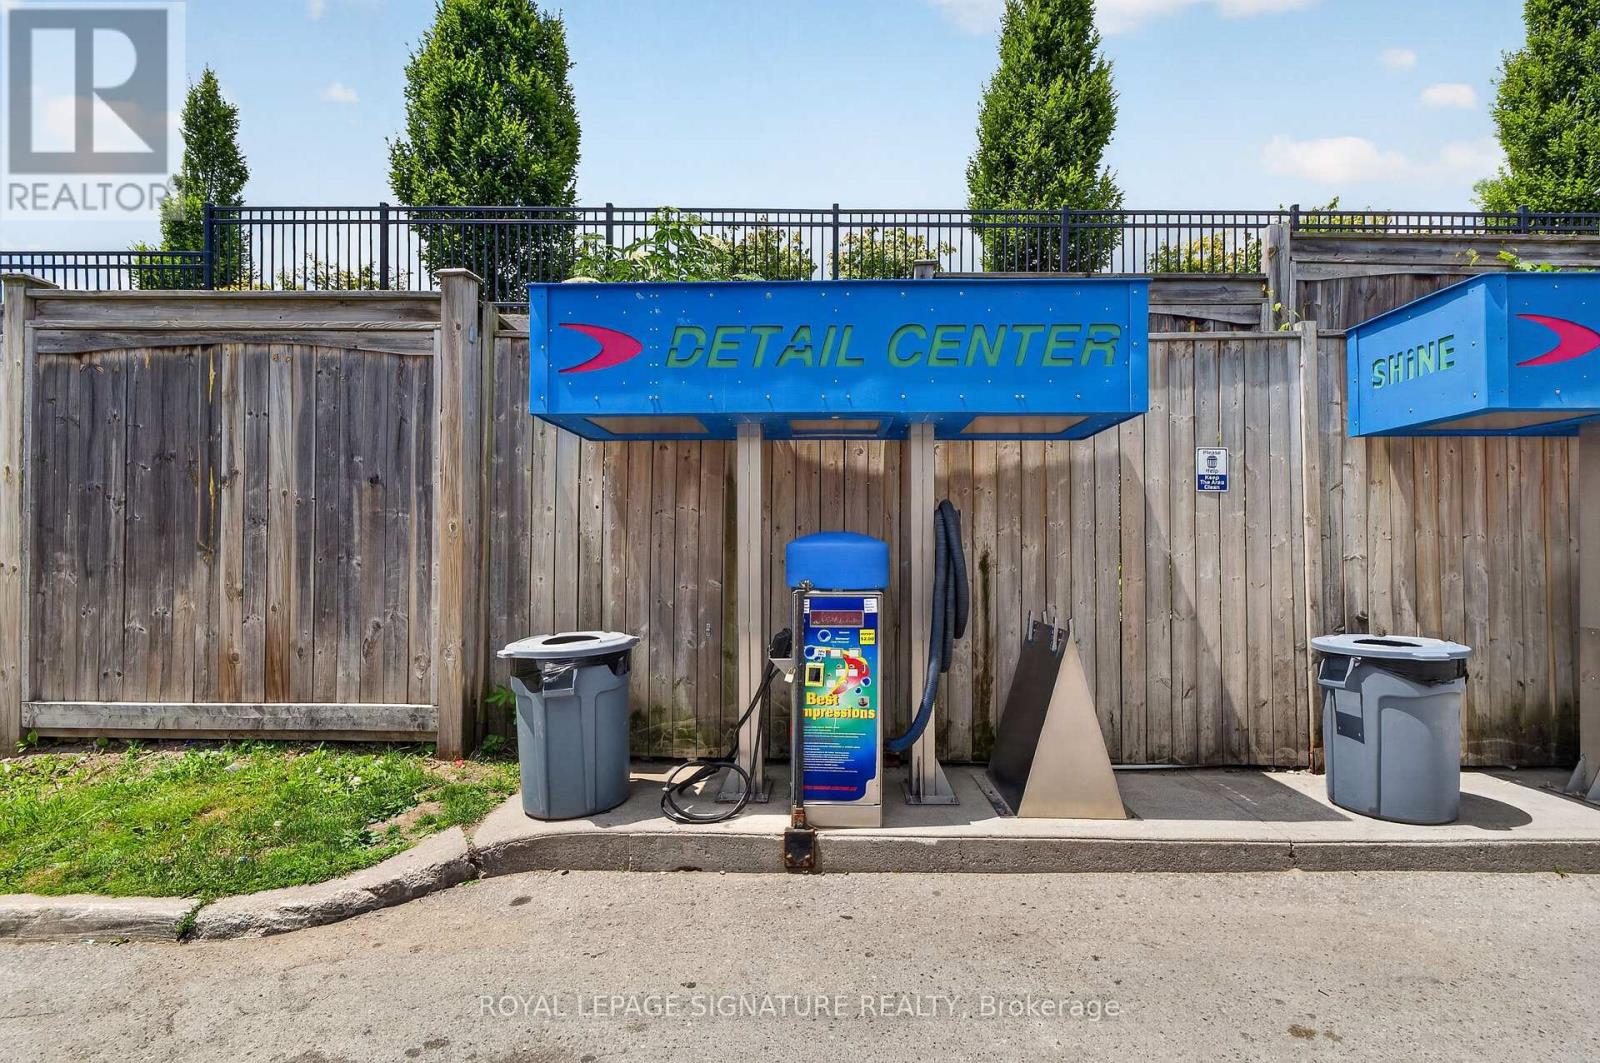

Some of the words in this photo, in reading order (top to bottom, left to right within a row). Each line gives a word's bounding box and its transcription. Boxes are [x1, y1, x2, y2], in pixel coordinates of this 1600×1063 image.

[665, 324, 866, 368] DETAIL
[887, 323, 1122, 367] CENTER
[806, 691, 840, 706] Best
